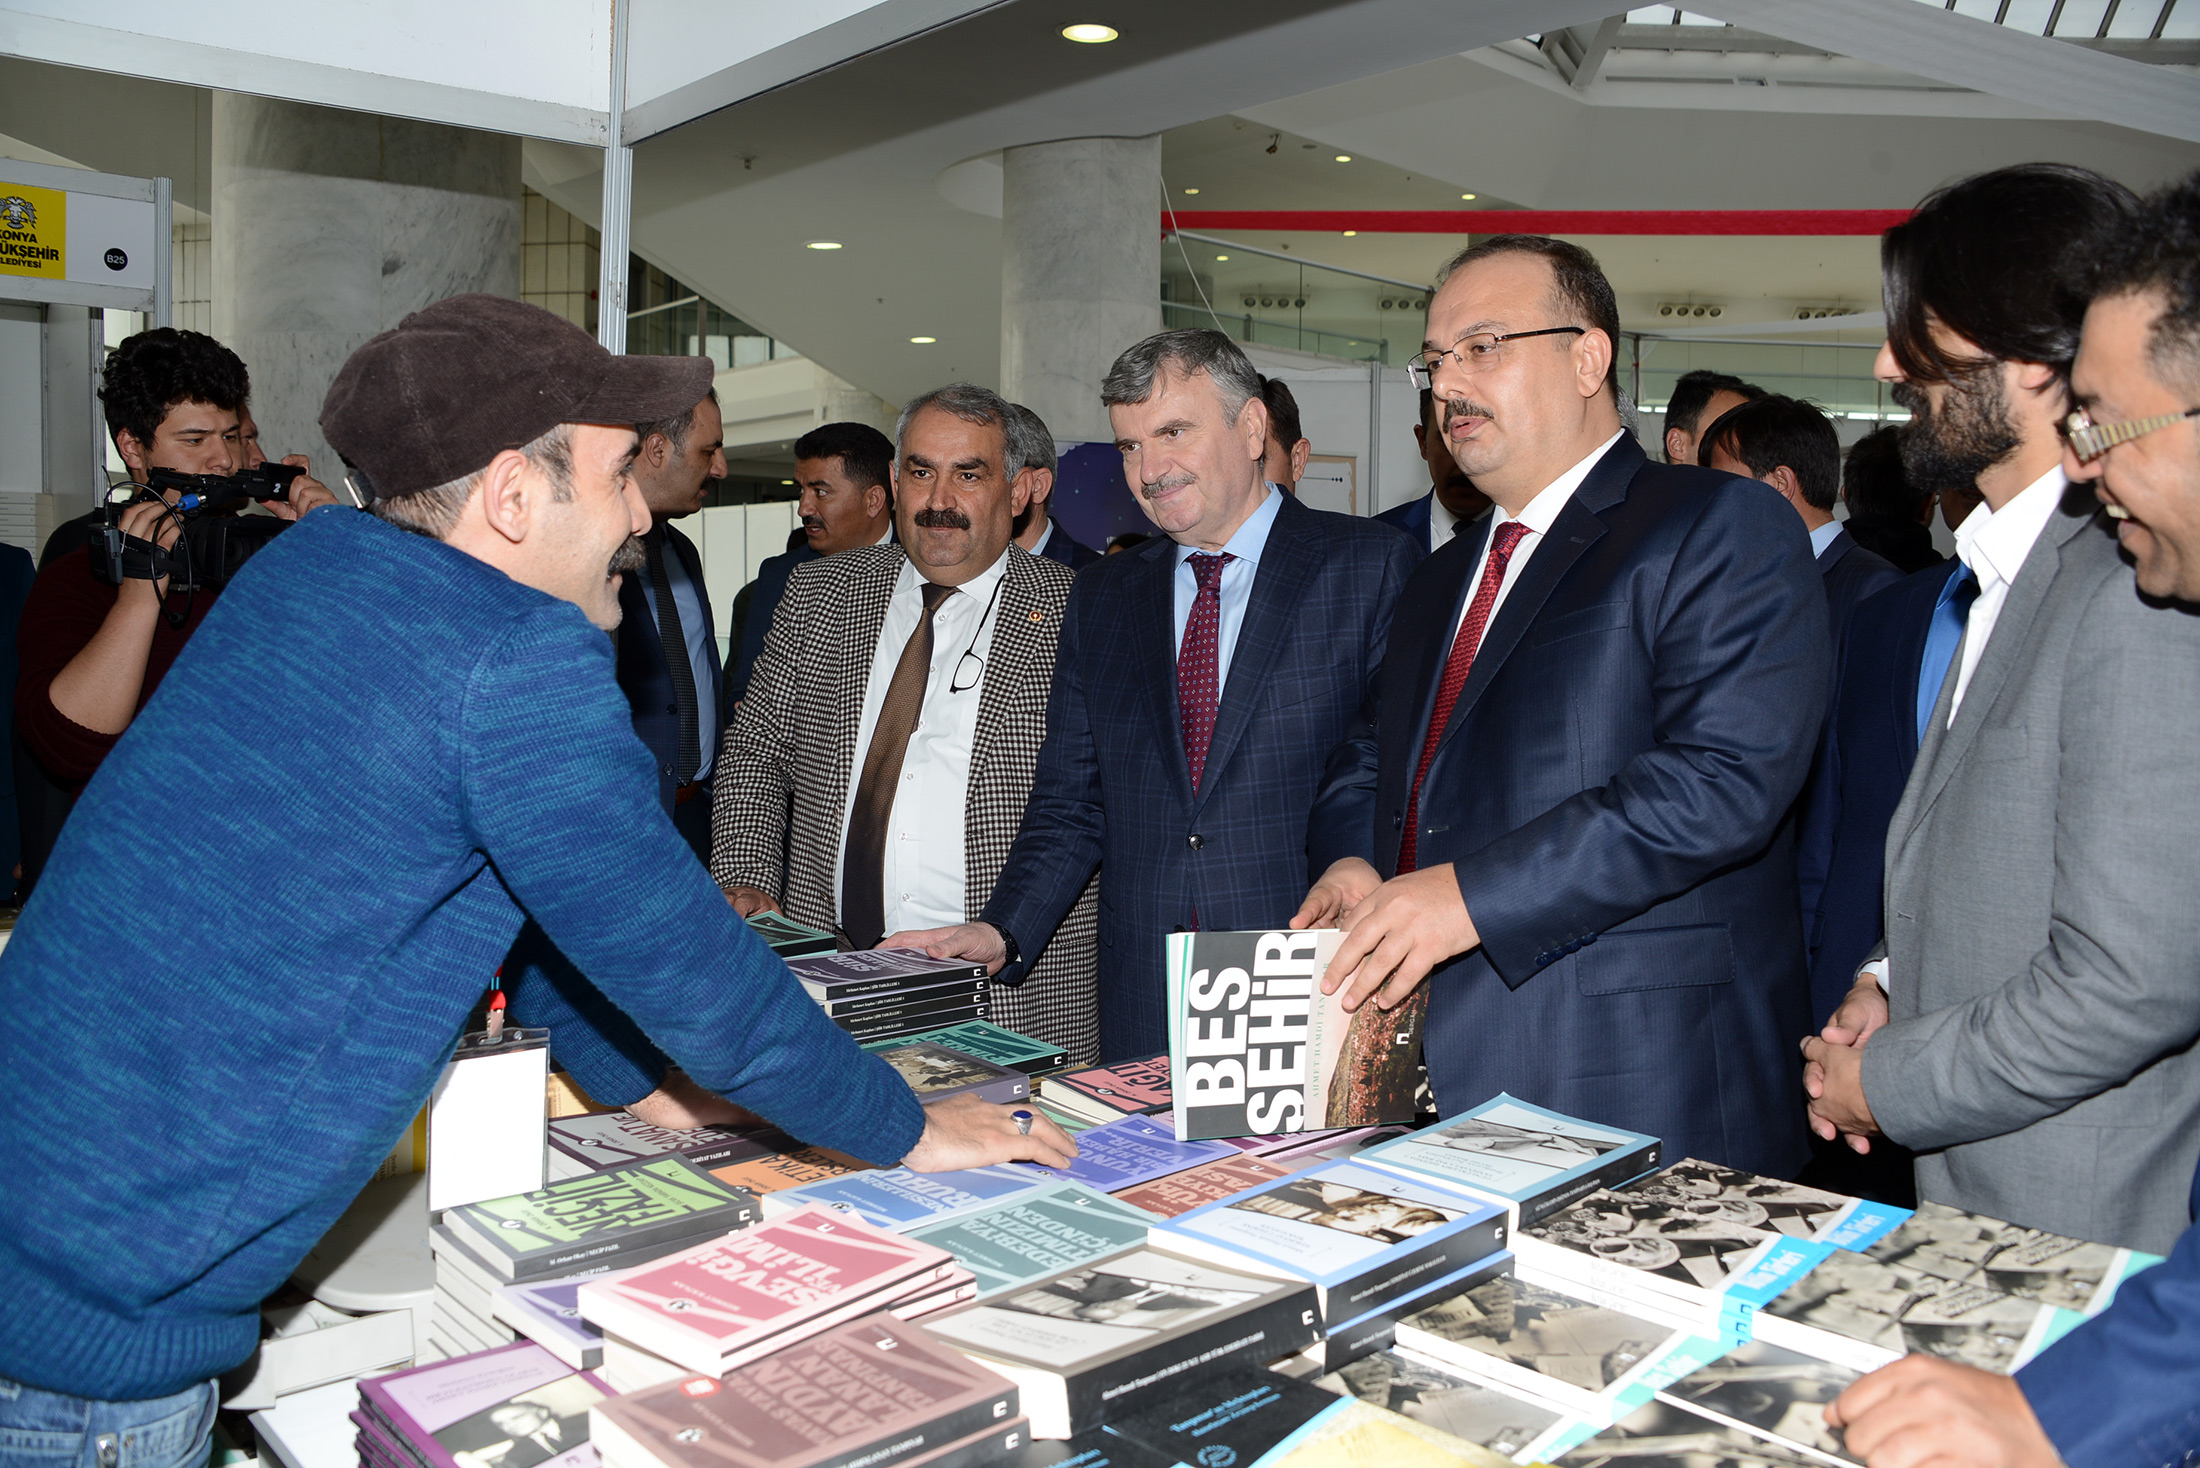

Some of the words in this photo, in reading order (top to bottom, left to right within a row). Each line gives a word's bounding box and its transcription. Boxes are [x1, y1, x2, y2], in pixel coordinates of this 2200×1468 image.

[0, 240, 60, 261] ÜKŞEHİR
[0, 256, 42, 269] LEDİYESİ
[106, 254, 126, 265] B25
[273, 483, 281, 494] 2
[1186, 966, 1250, 1108] BES
[1312, 1060, 1320, 1099] AHMET
[759, 1154, 826, 1183] ETİKA
[1074, 1140, 1152, 1178] YUNU
[883, 1170, 990, 1205] RUHU
[956, 1218, 1070, 1269] EDEBİYA
[979, 1212, 1092, 1261] TIMIZIN
[719, 1233, 842, 1283] İLİM
[681, 1248, 830, 1308] SEVGİ
[738, 1357, 880, 1435] AYDIN
[788, 1352, 910, 1422] LANAN
